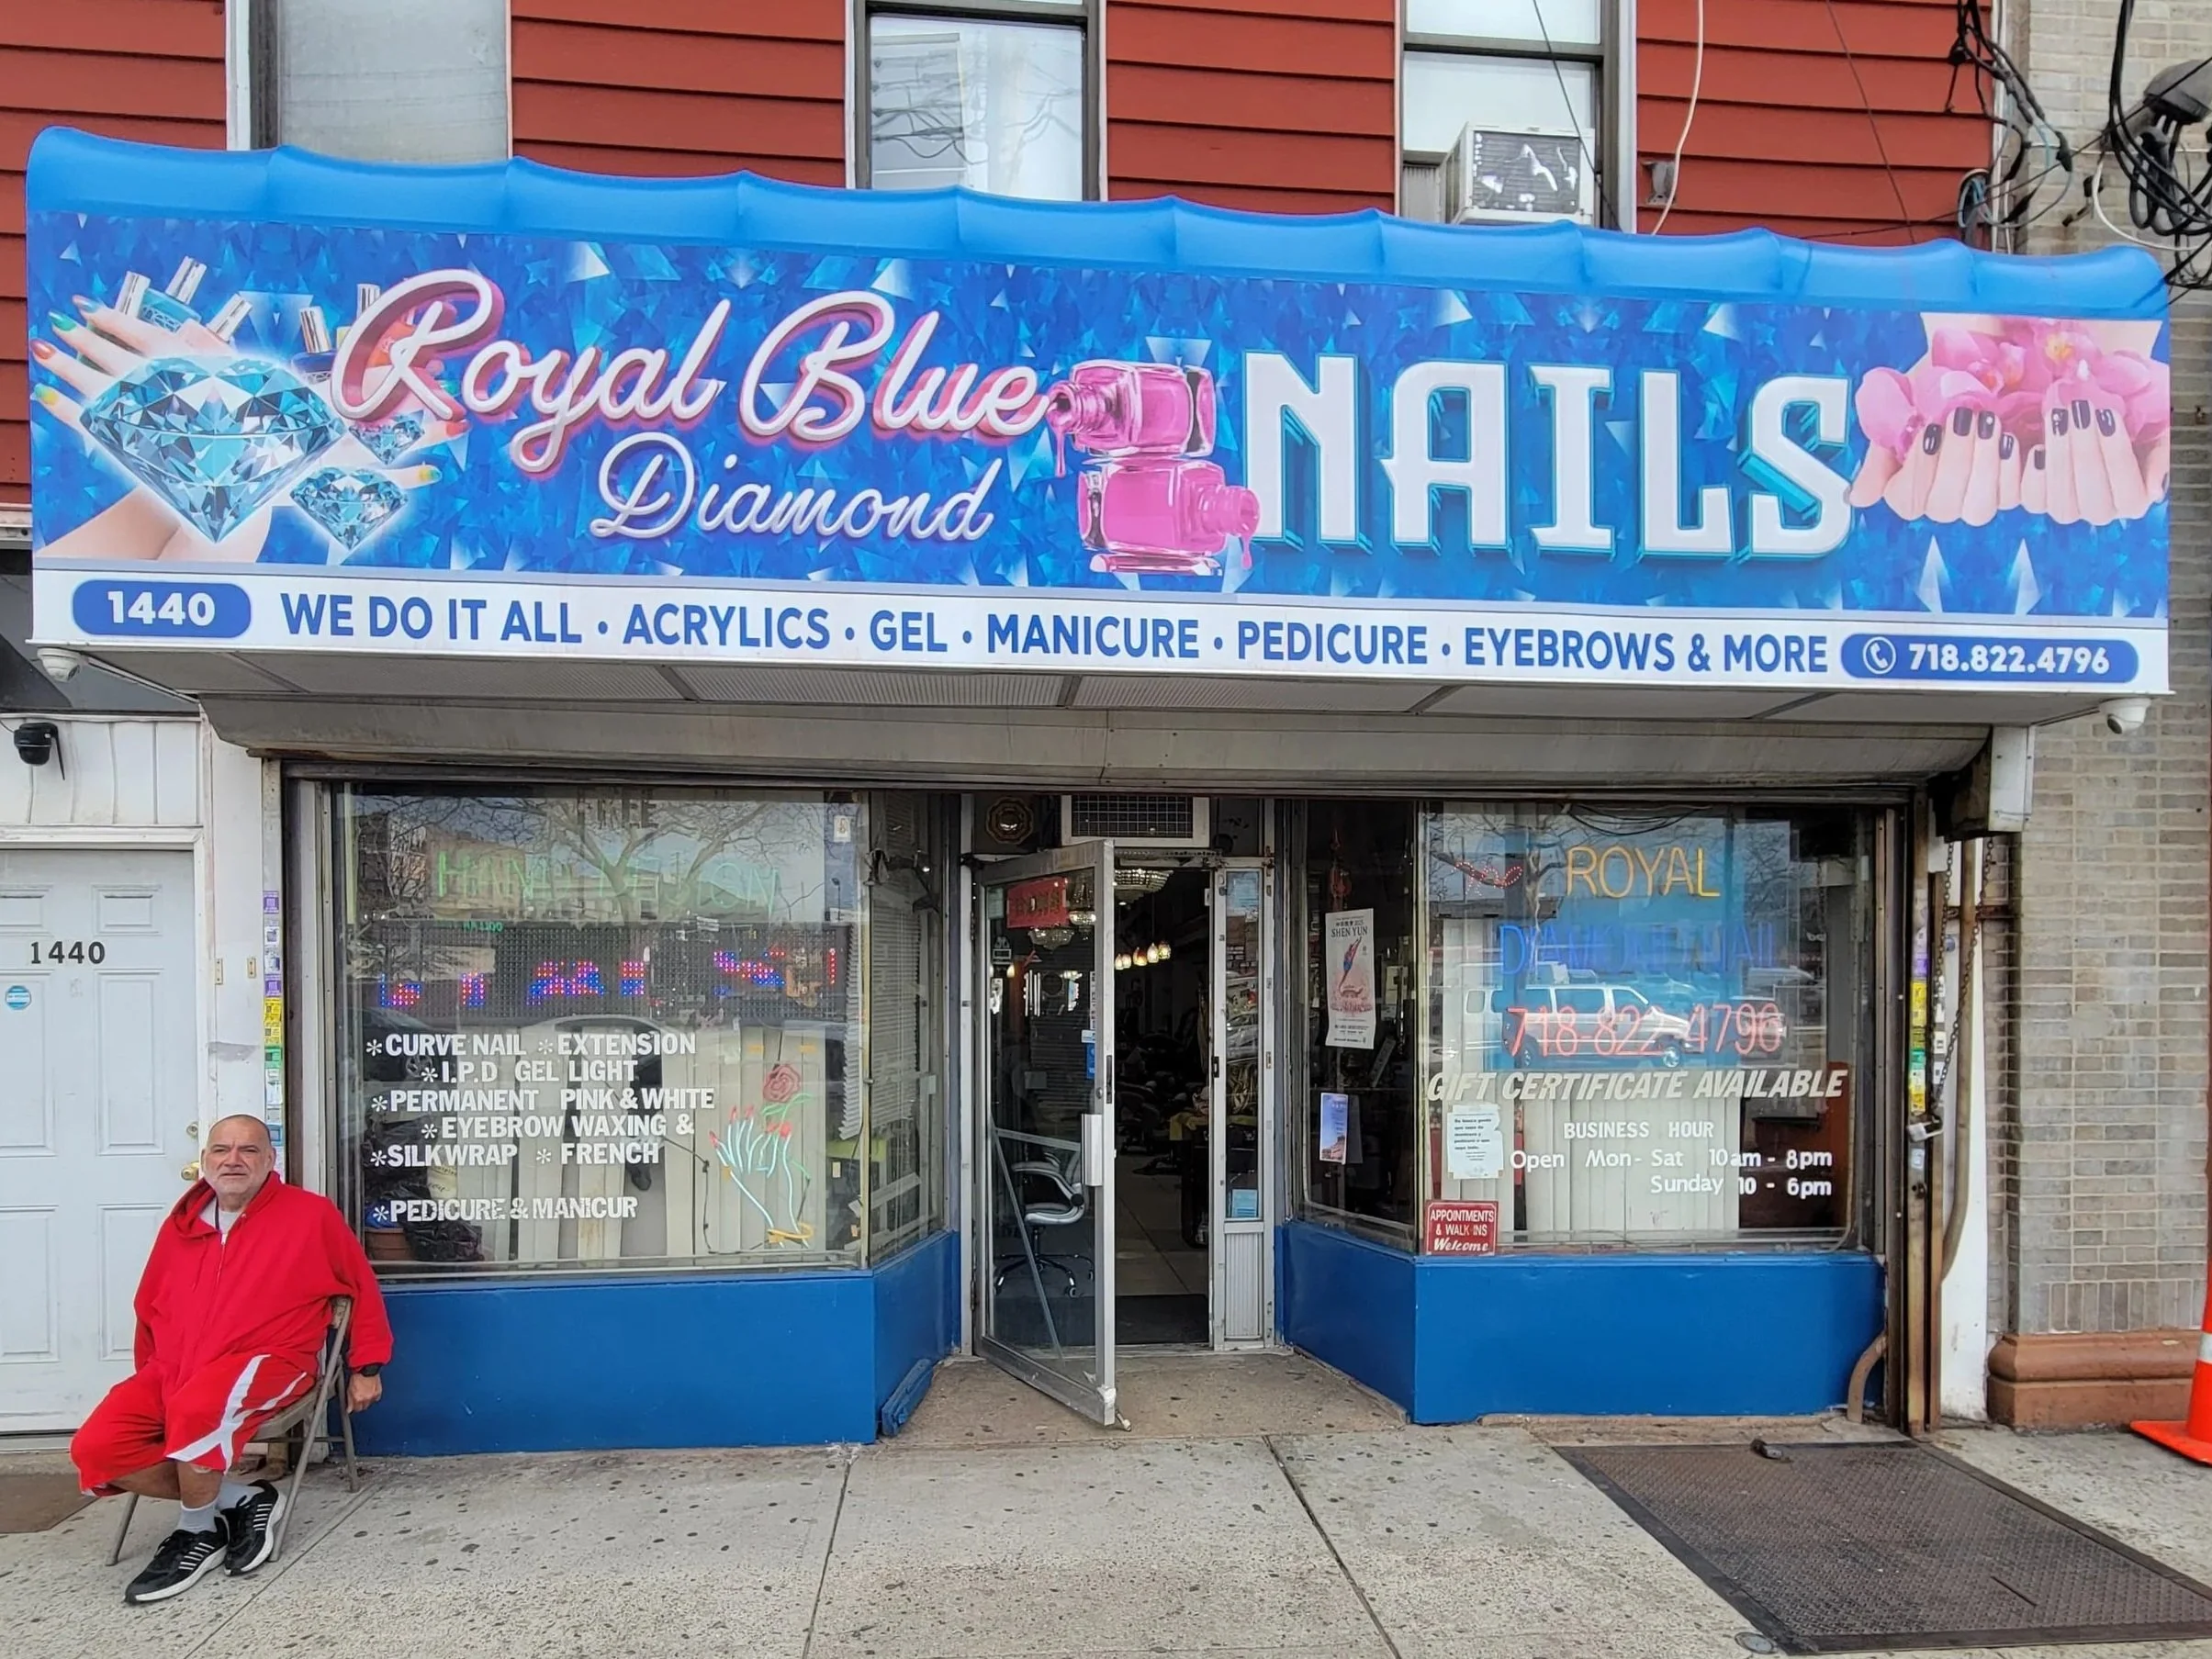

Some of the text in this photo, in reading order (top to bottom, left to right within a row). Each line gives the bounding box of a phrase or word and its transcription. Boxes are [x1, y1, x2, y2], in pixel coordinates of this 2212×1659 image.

[329, 267, 1052, 476] Royal Blue
[1243, 350, 1853, 559] NAILS
[589, 431, 1005, 542] Diamond
[107, 590, 216, 627] 1440
[281, 592, 1828, 672] WE DO IT ALL ACRYLICS GEL MANICURE PEDICURE EYEBROWS & MORE
[1908, 644, 2110, 675] 718.822.4796
[1566, 846, 1721, 899] ROYAL
[1331, 925, 1368, 937] SHEN YUN
[30, 941, 106, 965] 1440
[386, 1032, 696, 1057] CURVE NAIL EXTENSION
[442, 1059, 638, 1083] I.P.D GEL LIGHT
[1426, 1069, 1848, 1102] GIFT CERTIFICATE AVAILABLE
[390, 1087, 715, 1113] PERMANENT PINK & WHITE
[442, 1113, 694, 1138] EYEBROW WAXING &
[1563, 1120, 1714, 1139] BUSINESS HOUR
[560, 1142, 659, 1165] FRENCH
[1510, 1149, 1565, 1172] Open
[1651, 1149, 1683, 1167] Sat
[1785, 1149, 1833, 1171] 8pm
[1651, 1175, 1724, 1196] Sunday
[1736, 1177, 1756, 1194] 10
[1787, 1177, 1832, 1199] 6pm
[390, 1196, 638, 1222] PEDICURE & MANICUR
[1430, 1209, 1494, 1223] APPOINTMENTS
[1435, 1223, 1488, 1237] & WALK INS
[1434, 1237, 1488, 1251] Welcome
